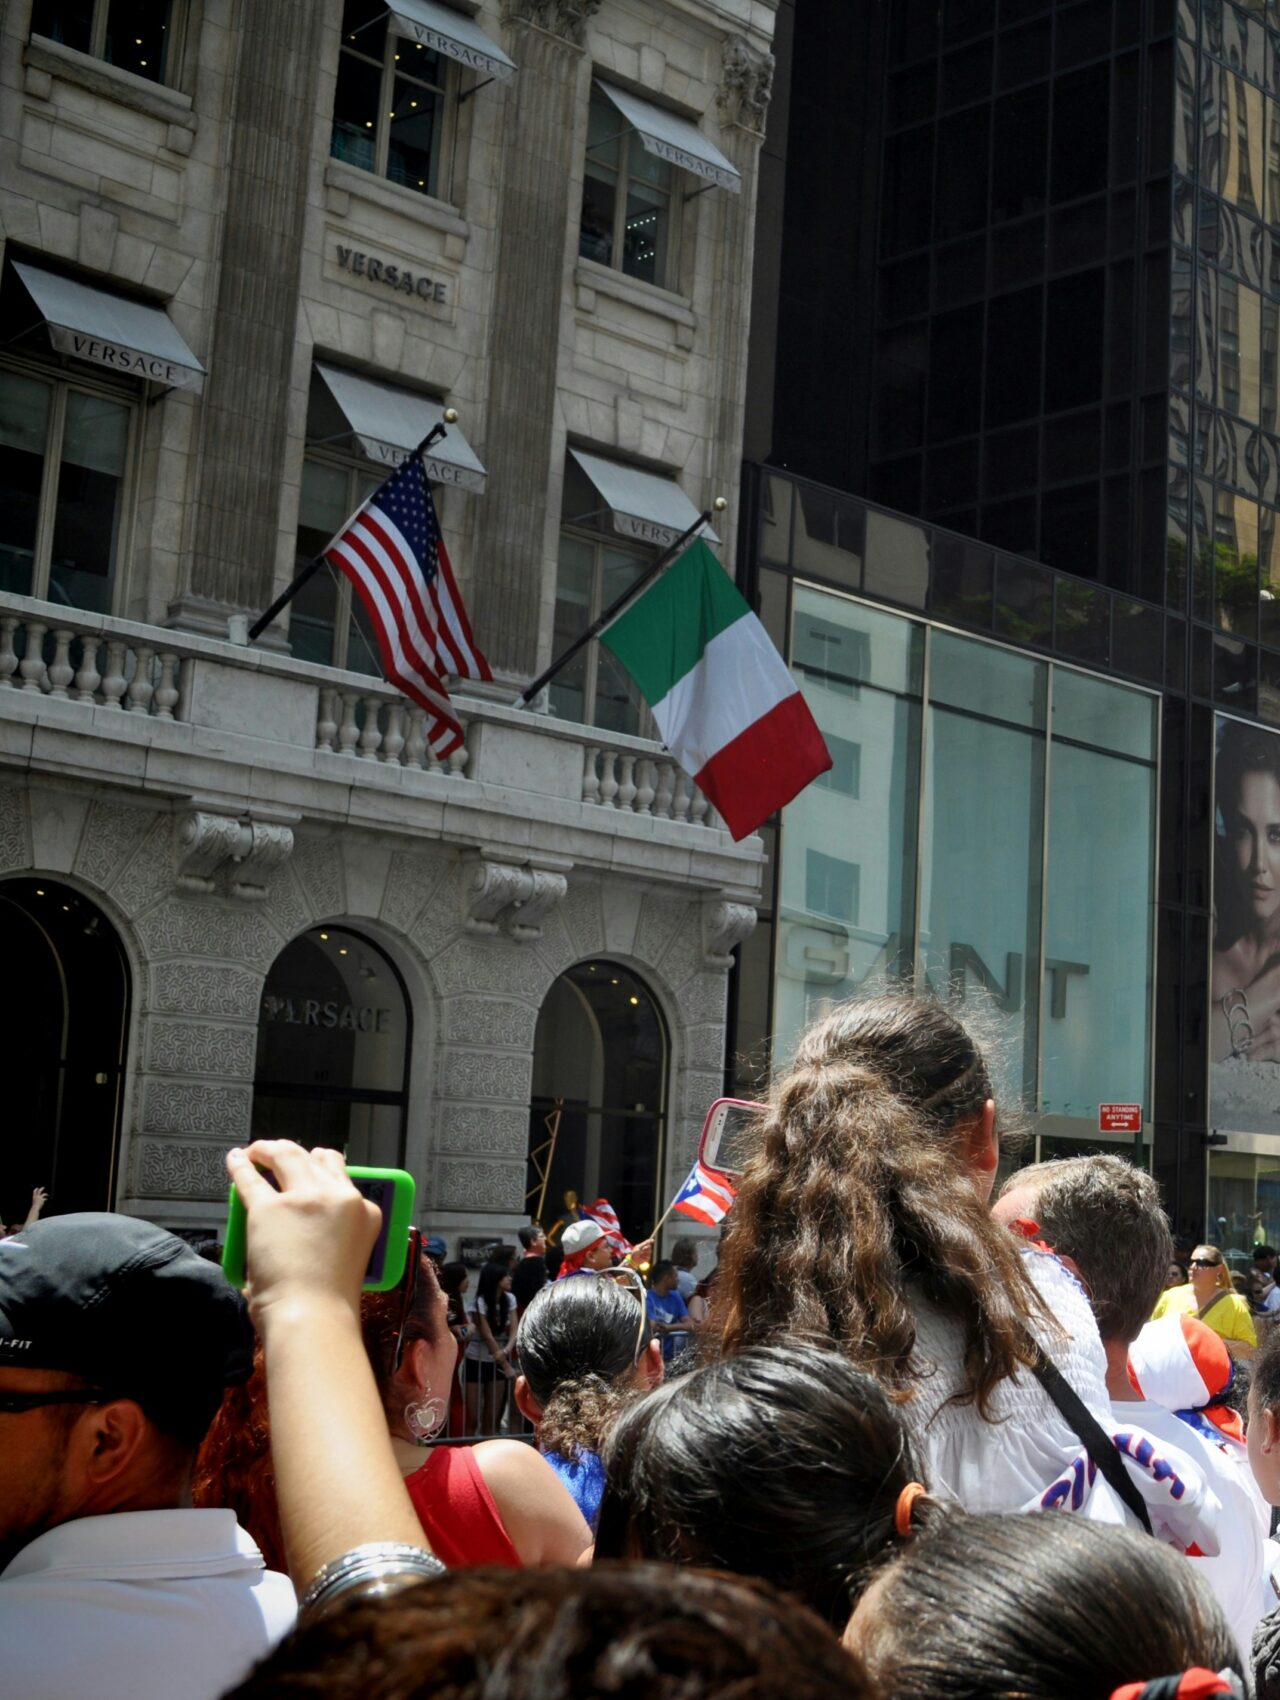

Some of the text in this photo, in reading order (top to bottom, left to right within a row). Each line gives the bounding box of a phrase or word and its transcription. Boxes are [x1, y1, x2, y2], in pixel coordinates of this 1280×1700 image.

[413, 25, 495, 72] VERSACE
[655, 142, 722, 182] VERSACE
[336, 245, 447, 304] VERSACE
[73, 335, 177, 381] VERSACE
[378, 446, 462, 484] VEACE
